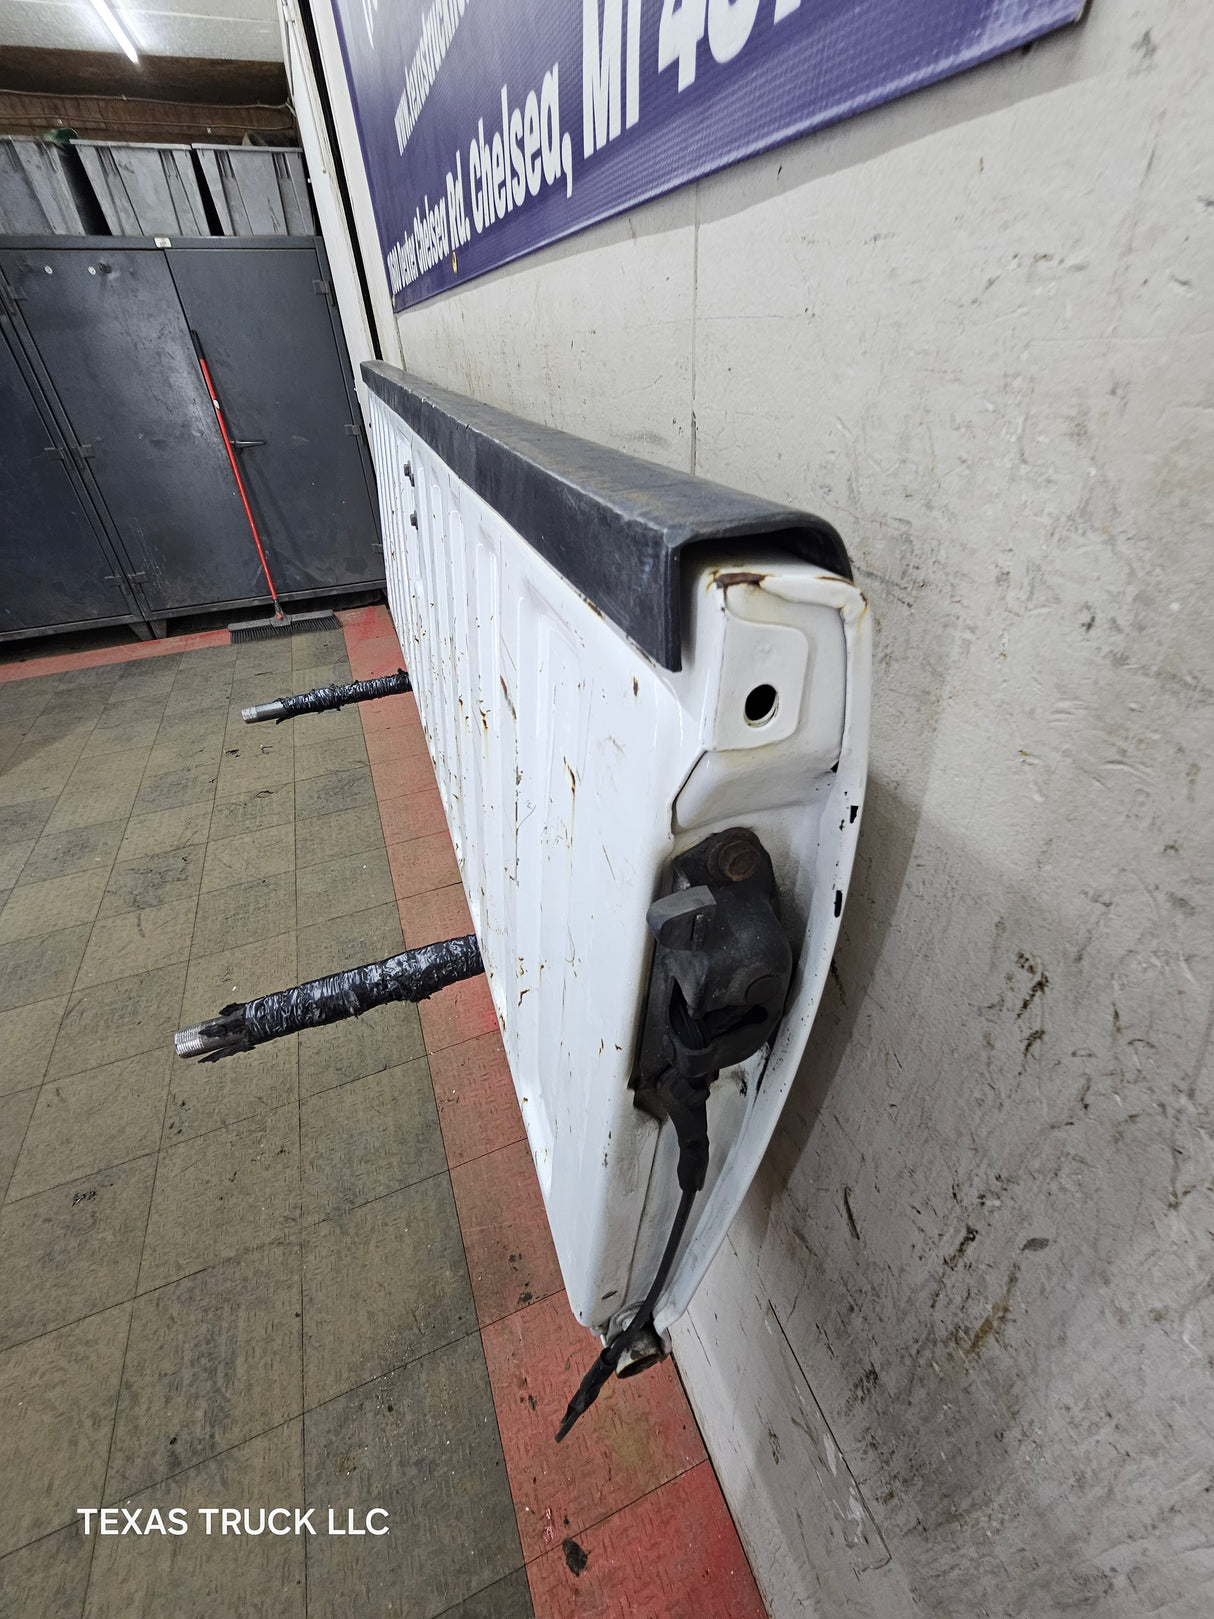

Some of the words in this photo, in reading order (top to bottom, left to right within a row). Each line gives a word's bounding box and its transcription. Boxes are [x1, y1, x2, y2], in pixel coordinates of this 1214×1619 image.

[413, 194, 450, 275] Chelsea
[446, 149, 471, 251] Rd.
[469, 62, 573, 234] Chelsea,
[583, 0, 642, 160] MI
